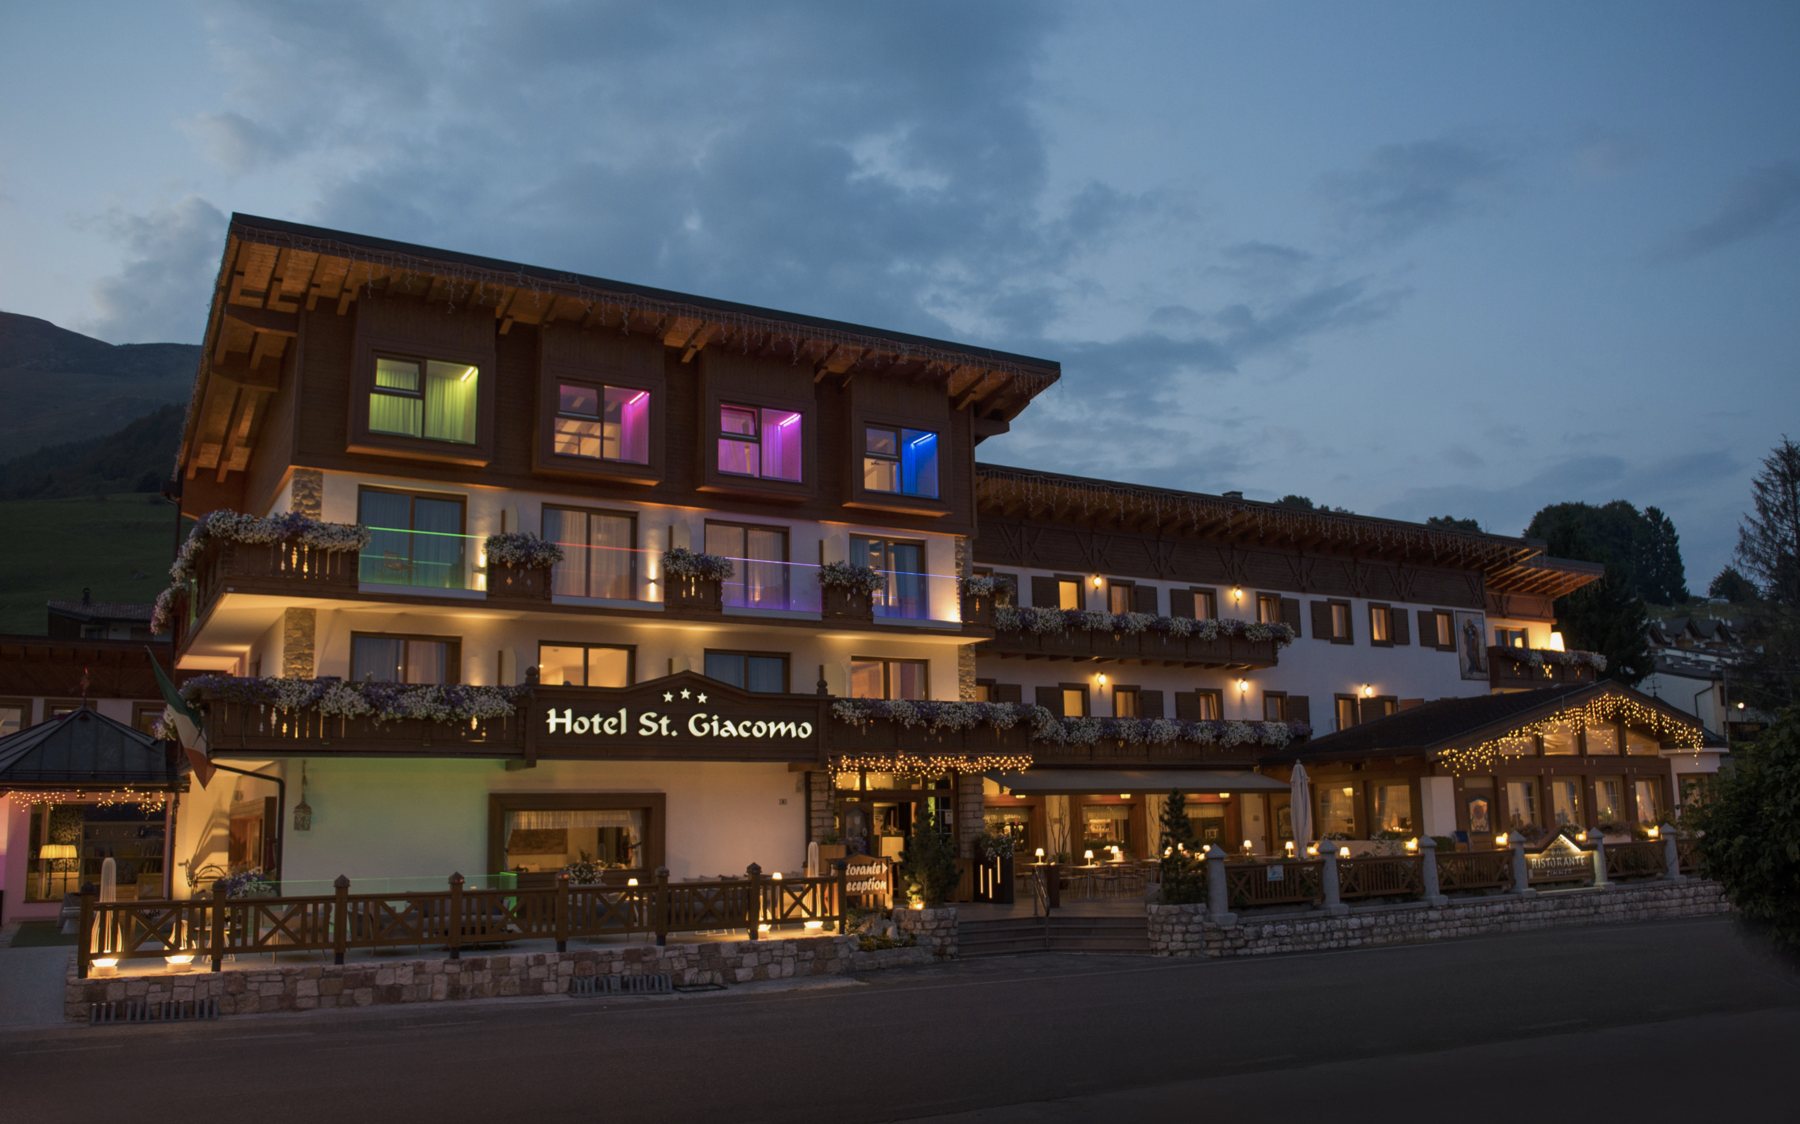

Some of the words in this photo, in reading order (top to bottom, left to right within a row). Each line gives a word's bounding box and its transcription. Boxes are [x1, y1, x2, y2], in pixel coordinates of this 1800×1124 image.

[546, 707, 627, 735] Hotel
[639, 711, 678, 737] St.
[687, 712, 813, 739] Giacomo
[845, 862, 881, 876] torante
[1531, 855, 1586, 869] RISTORANTE
[846, 877, 887, 894] eception
